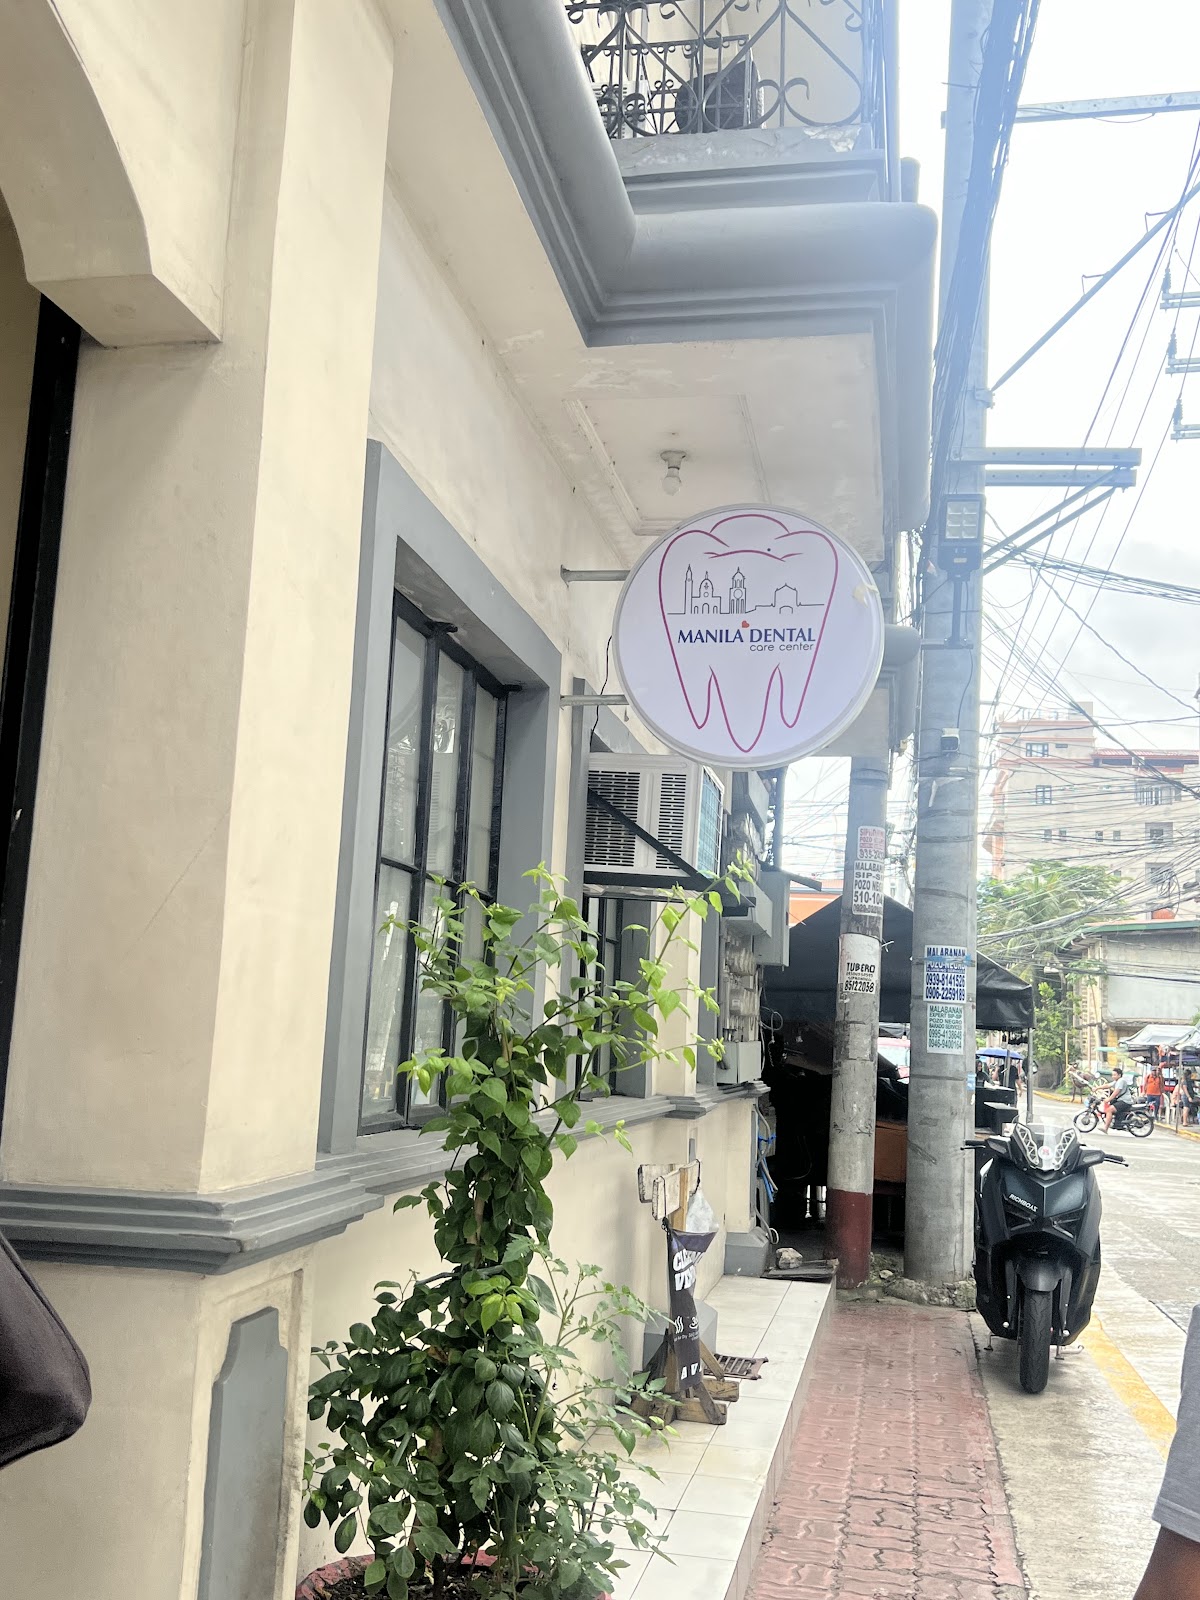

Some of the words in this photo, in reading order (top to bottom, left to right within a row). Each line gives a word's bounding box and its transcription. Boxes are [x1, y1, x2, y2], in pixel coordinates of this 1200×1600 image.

[678, 629, 744, 643] MANILA
[749, 628, 816, 642] DENTAL
[778, 643, 814, 651] center
[854, 880, 871, 891] POZO
[846, 962, 876, 973] TUBERO
[929, 1005, 963, 1014] MALABANAN
